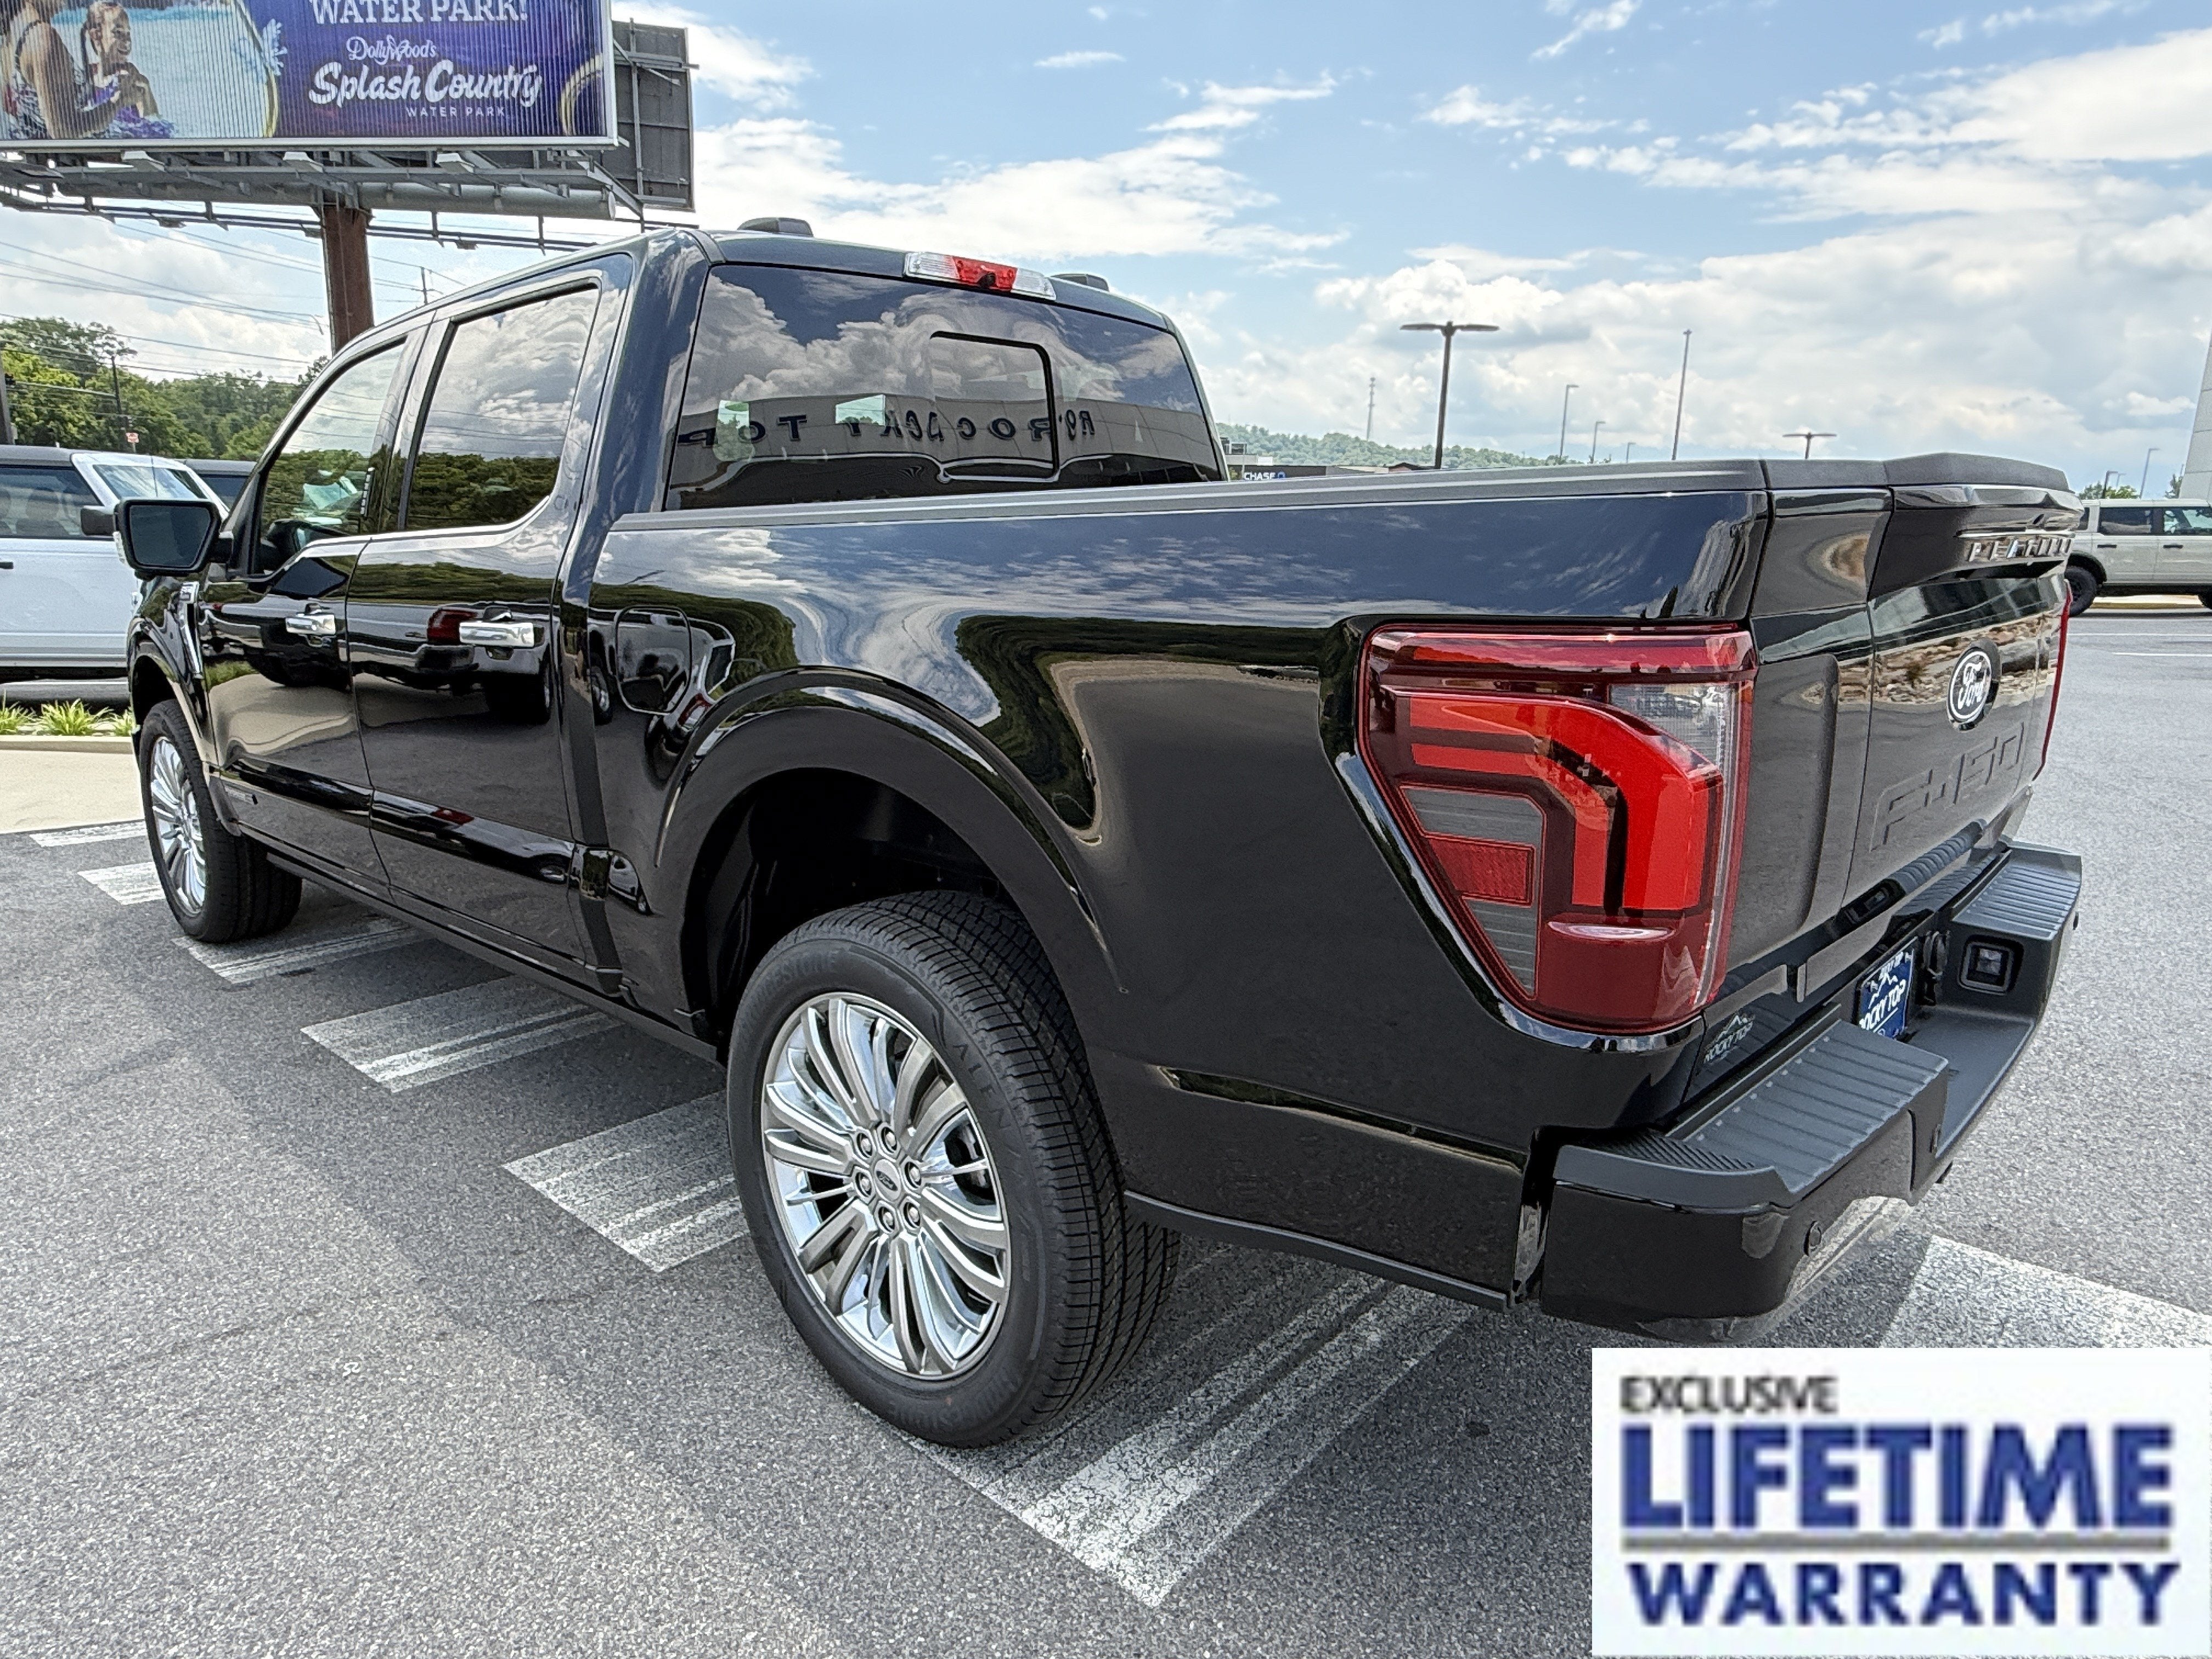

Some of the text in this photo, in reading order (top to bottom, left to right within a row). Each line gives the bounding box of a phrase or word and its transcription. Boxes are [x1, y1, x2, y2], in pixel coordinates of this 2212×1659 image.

[309, 0, 528, 24] WATER PARK!
[308, 59, 543, 108] Splash Country
[406, 106, 505, 117] WATER PARK
[1244, 472, 1276, 481] CHASE
[1957, 661, 1988, 710] Ford
